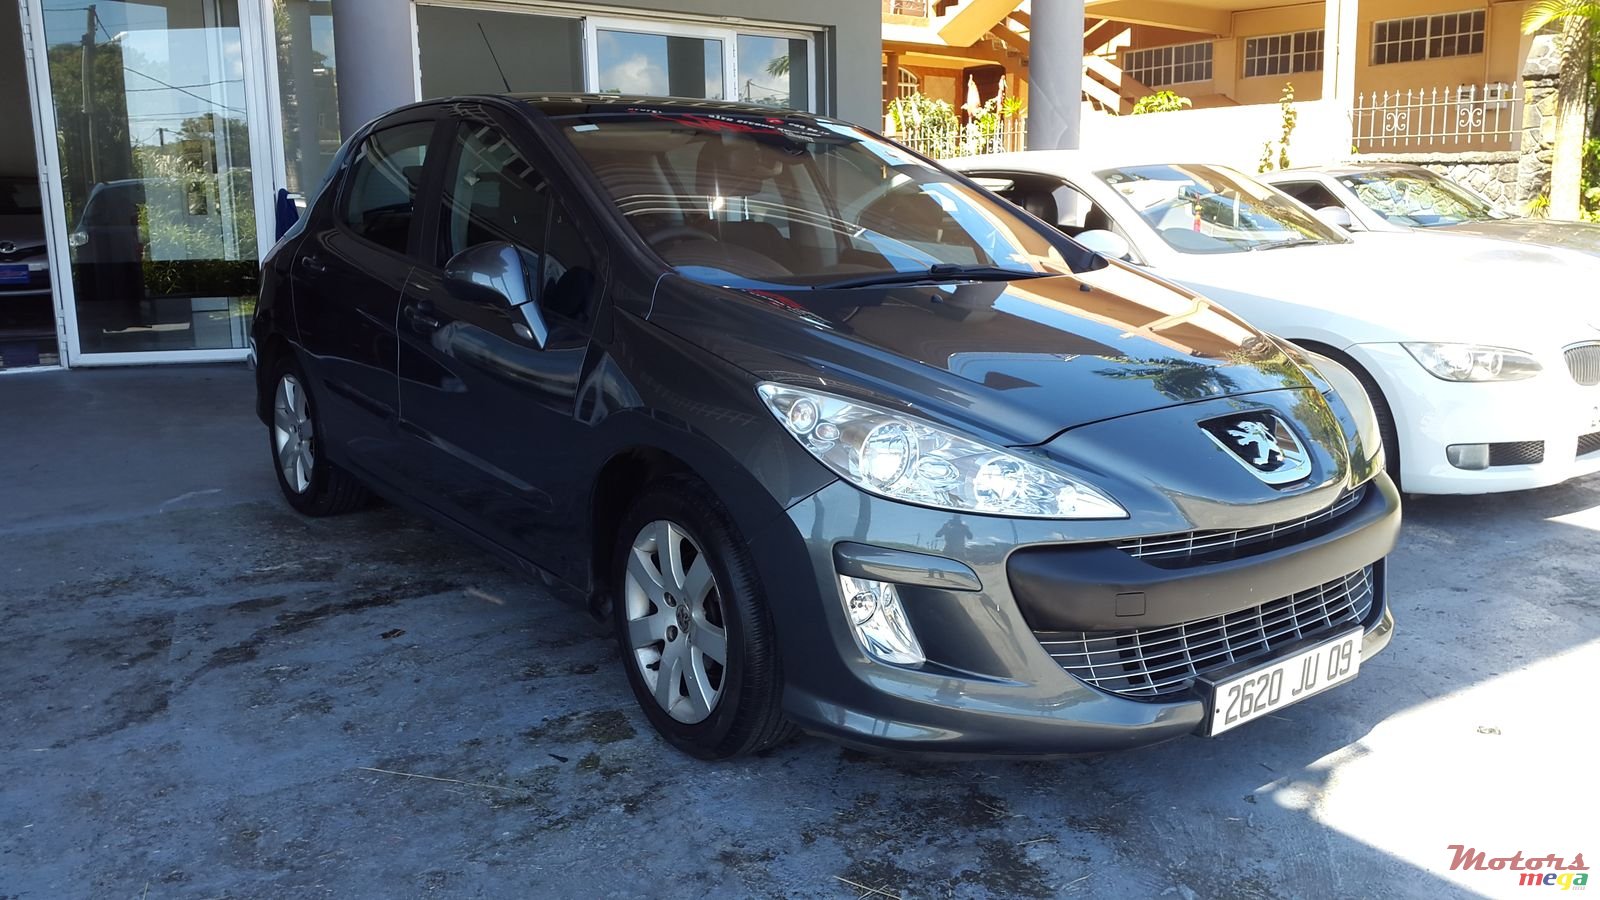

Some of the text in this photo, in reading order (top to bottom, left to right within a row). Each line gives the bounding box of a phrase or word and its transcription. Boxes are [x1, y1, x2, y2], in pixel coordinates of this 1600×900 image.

[1224, 639, 1353, 725] 2620 JU 09
